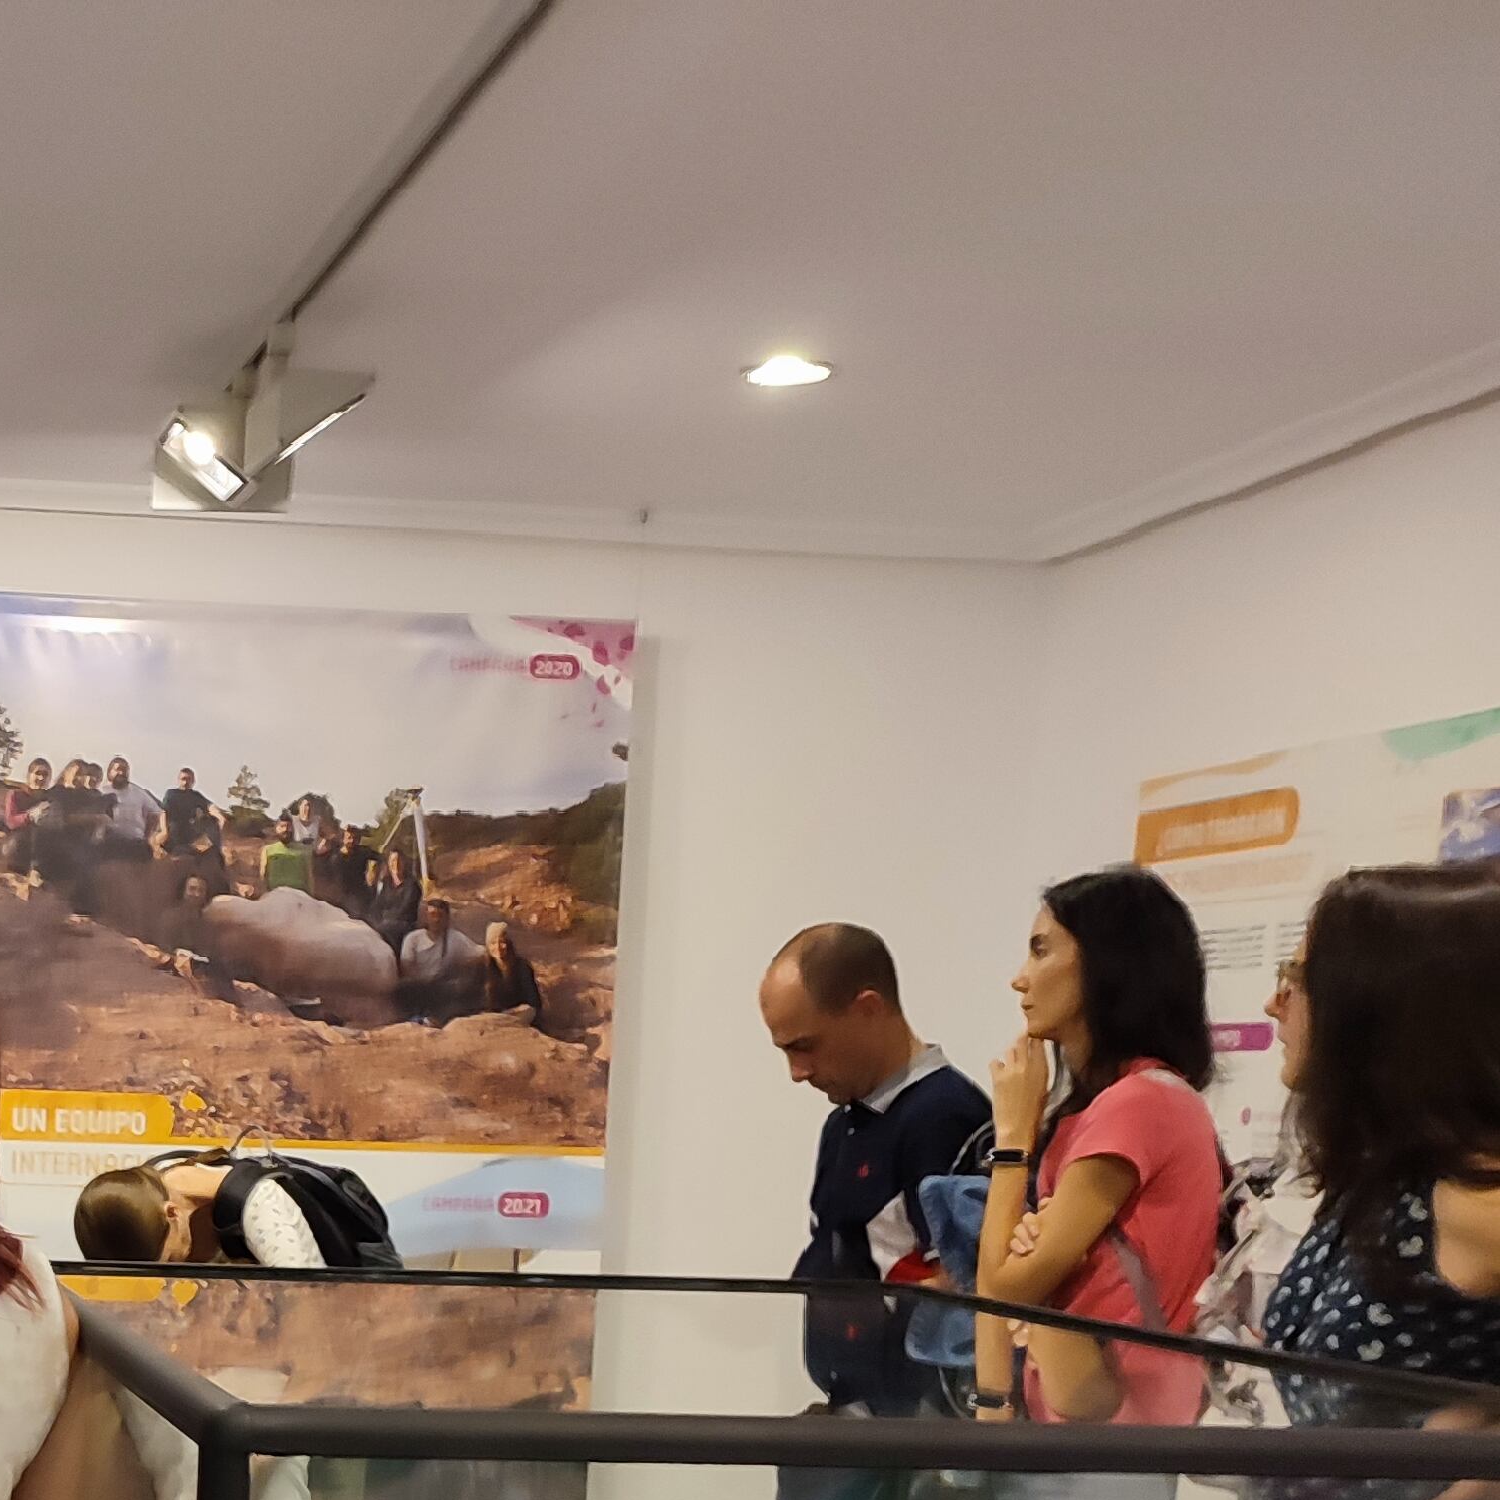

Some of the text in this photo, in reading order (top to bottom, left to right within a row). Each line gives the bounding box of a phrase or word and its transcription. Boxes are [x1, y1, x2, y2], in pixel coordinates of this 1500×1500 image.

[534, 660, 573, 676] 2020
[12, 1107, 147, 1135] UN EQUIPO
[503, 1198, 541, 1215] 2021
